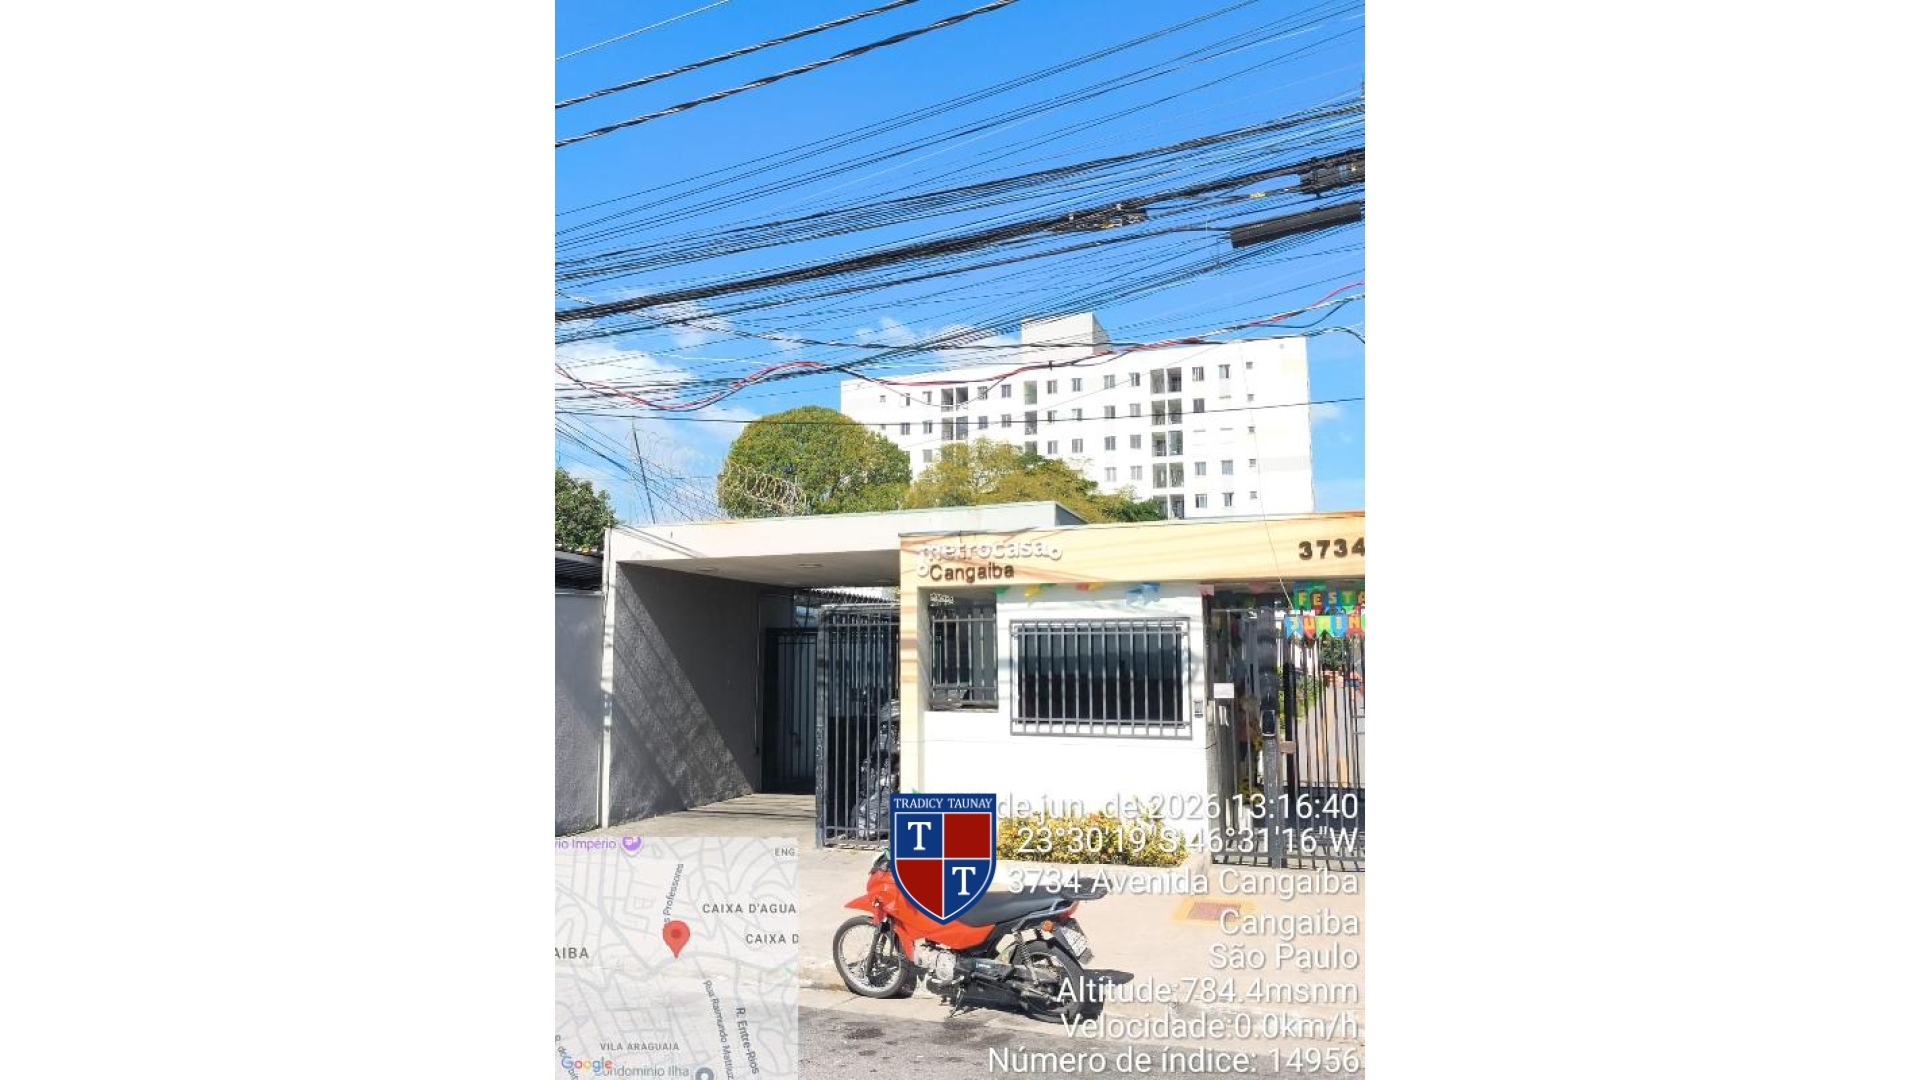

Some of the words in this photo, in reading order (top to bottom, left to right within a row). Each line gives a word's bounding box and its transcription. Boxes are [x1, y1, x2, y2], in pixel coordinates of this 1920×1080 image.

[921, 539, 1048, 562] metrocasa
[1299, 537, 1365, 560] 3734
[930, 562, 1015, 583] Cangaiba
[1298, 590, 1365, 606] FESTA
